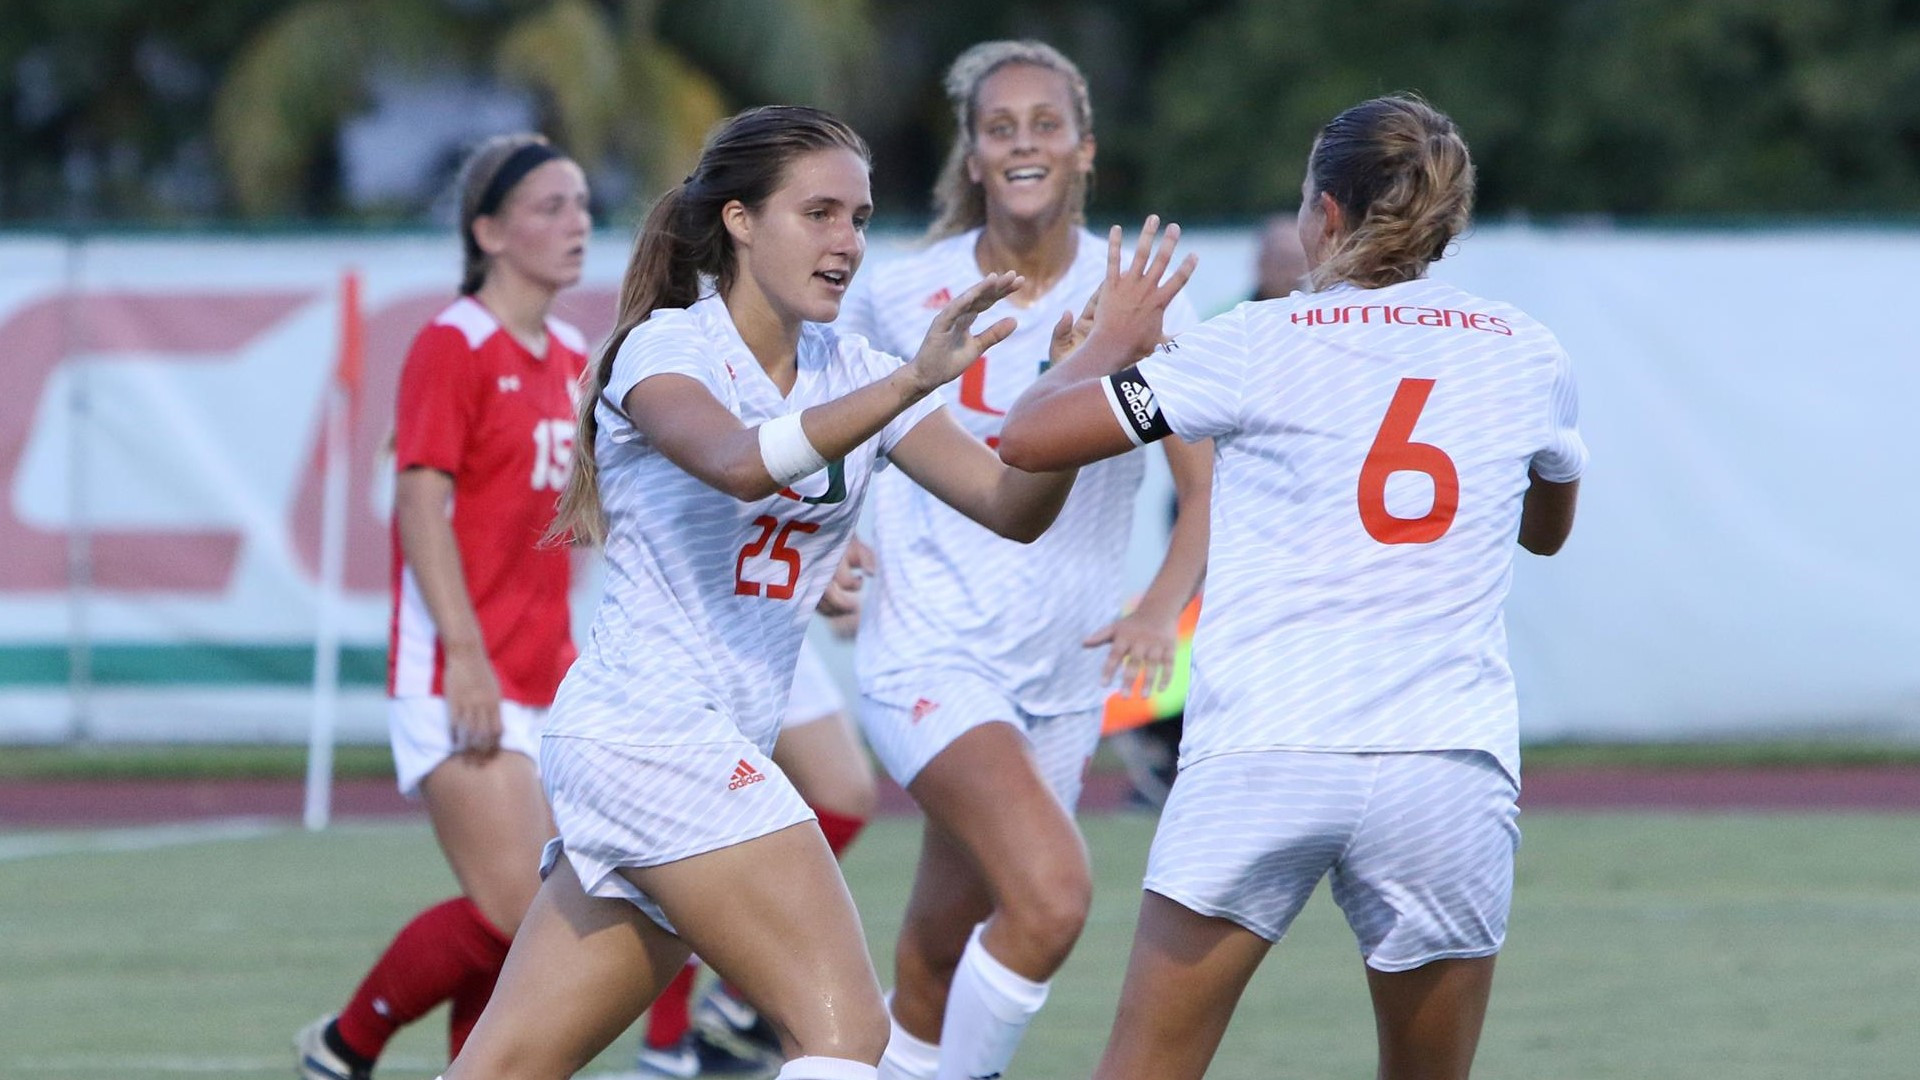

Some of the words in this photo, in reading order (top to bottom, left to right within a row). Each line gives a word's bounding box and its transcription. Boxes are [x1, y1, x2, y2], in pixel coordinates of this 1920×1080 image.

[1120, 381, 1152, 430] adidas
[530, 418, 578, 492] 15
[1357, 378, 1460, 545] 6
[734, 515, 821, 600] 25
[728, 773, 765, 791] adidas
